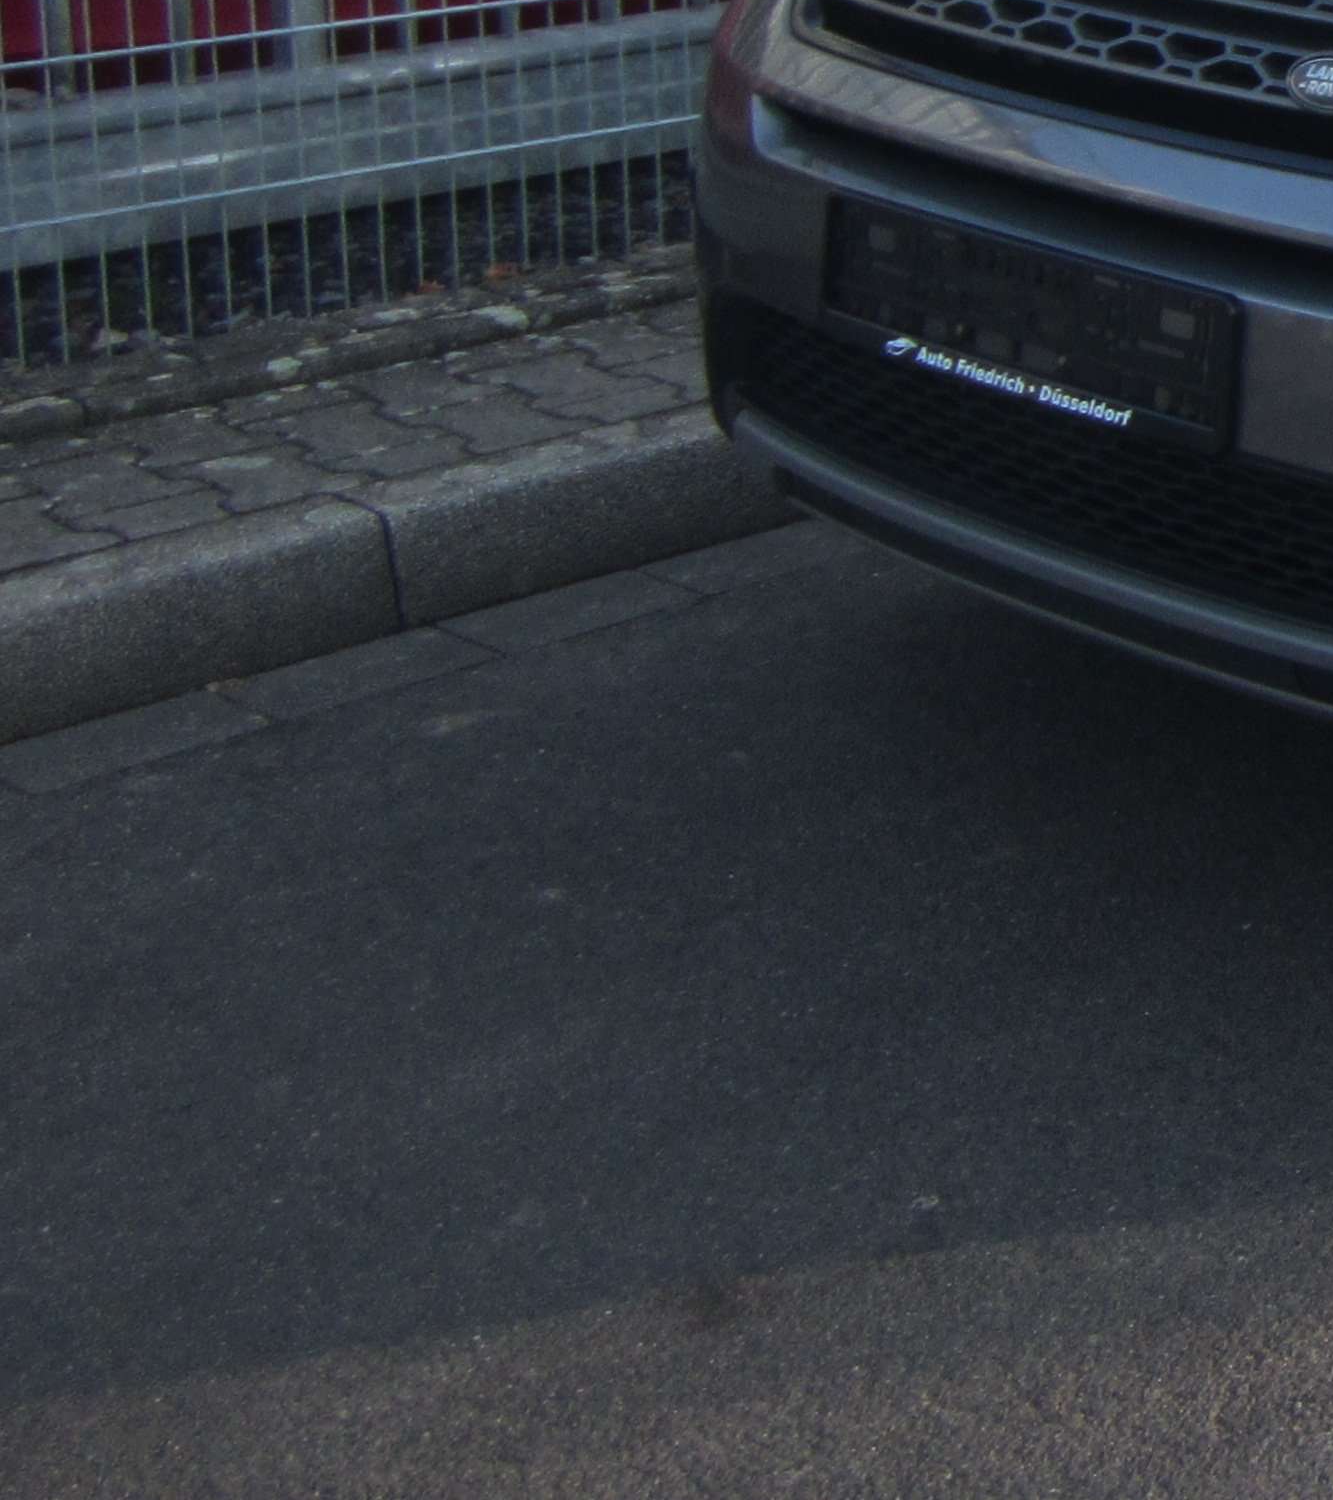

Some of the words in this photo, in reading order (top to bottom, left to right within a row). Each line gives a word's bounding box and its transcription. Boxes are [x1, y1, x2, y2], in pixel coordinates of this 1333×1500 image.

[915, 347, 953, 371] Auto
[955, 359, 1025, 395] Friedrich
[1038, 385, 1133, 427] Düsseldorf
